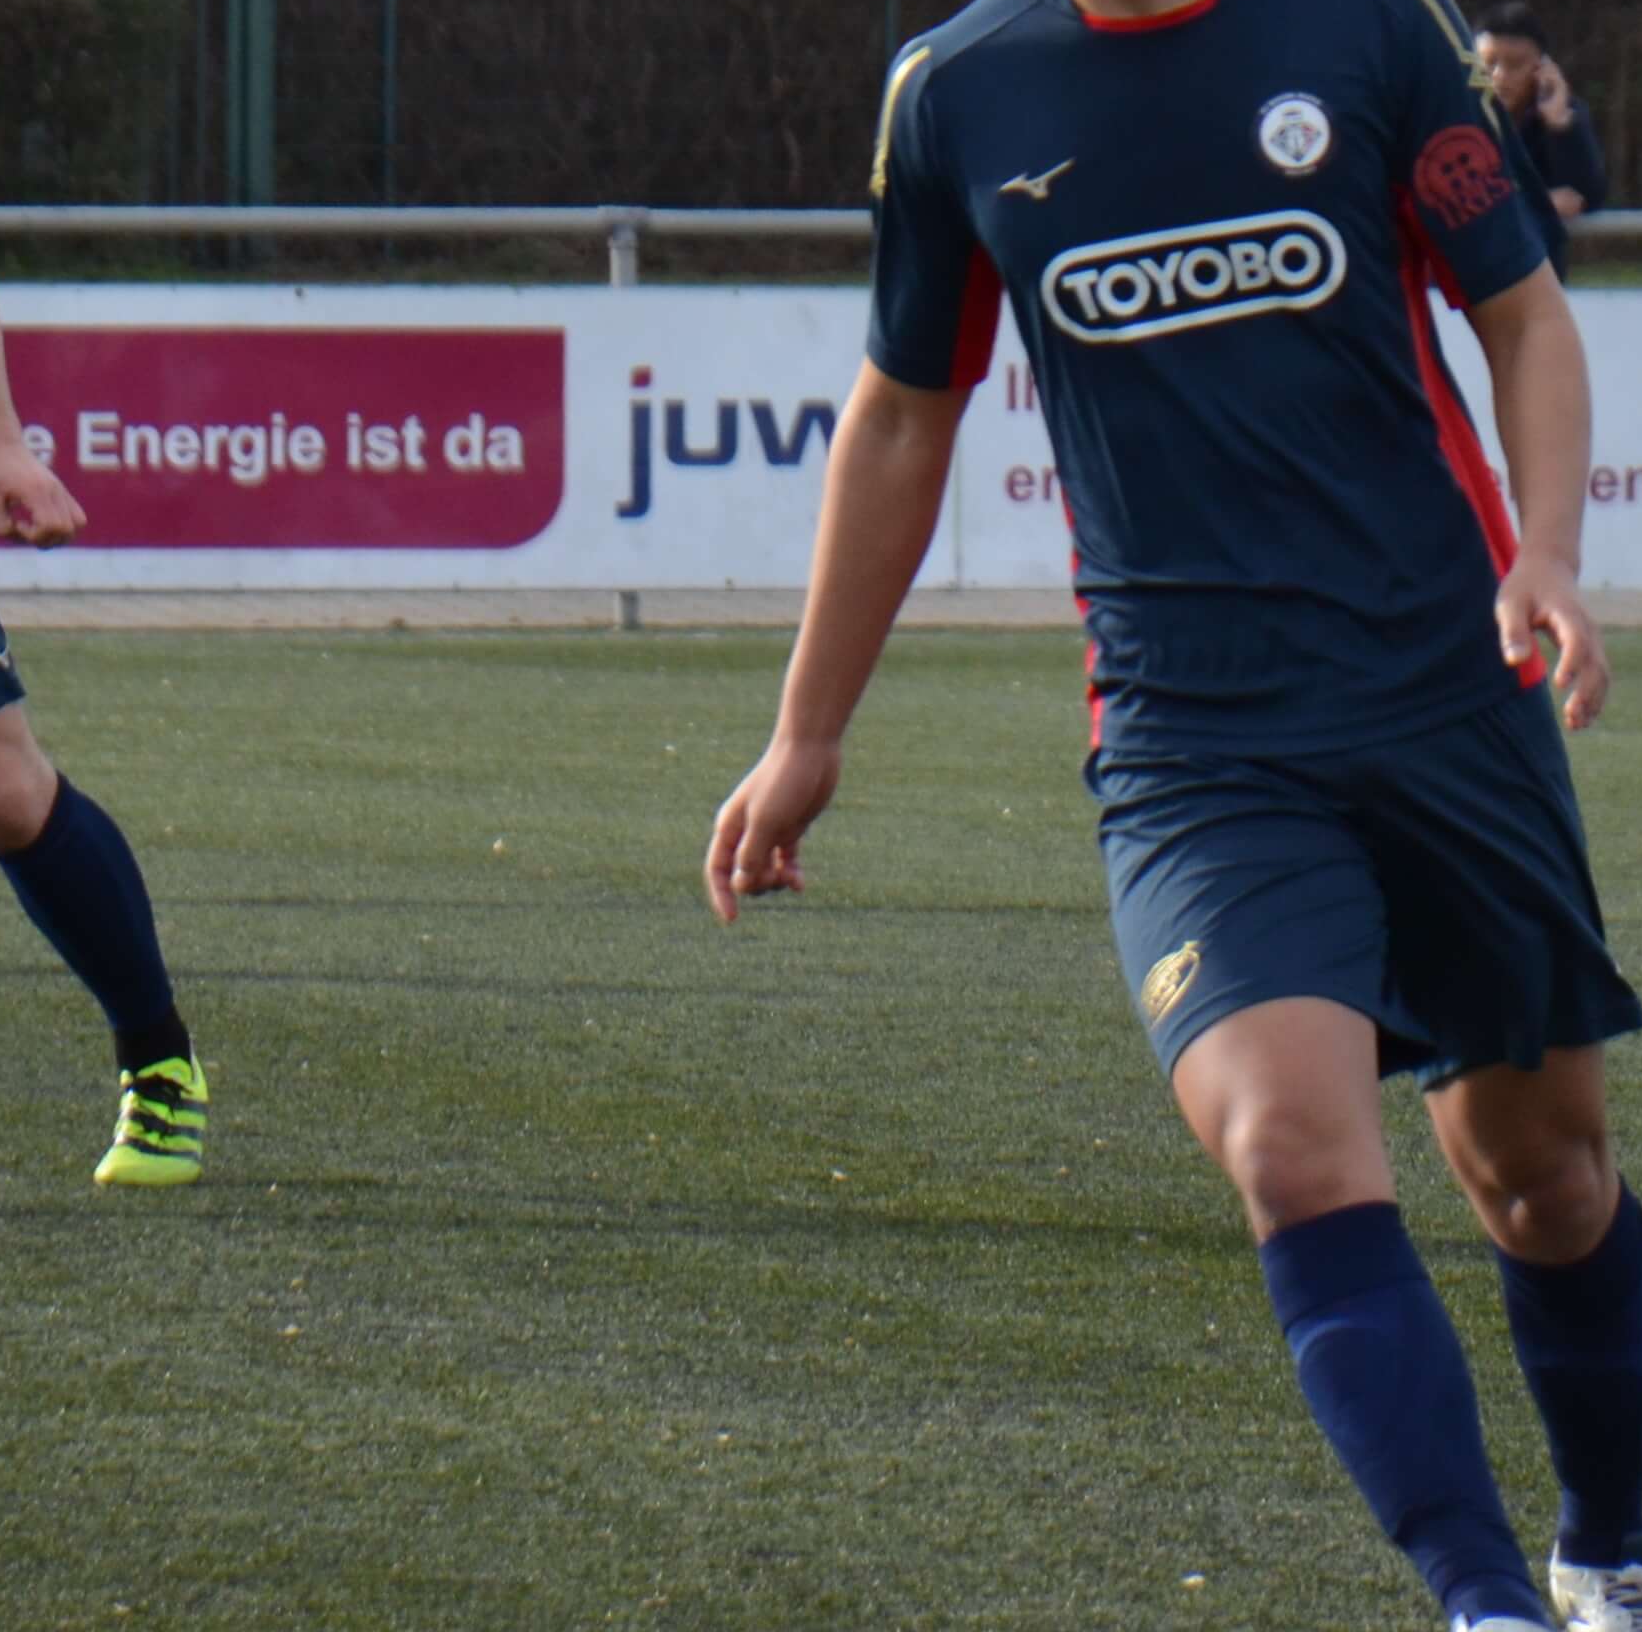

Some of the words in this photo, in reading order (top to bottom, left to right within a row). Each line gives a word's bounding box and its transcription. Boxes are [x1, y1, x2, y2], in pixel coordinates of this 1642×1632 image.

[1060, 232, 1322, 322] TOYOBO
[77, 412, 325, 486] Energie
[346, 412, 425, 468] ist
[444, 414, 524, 468] da
[615, 366, 839, 518] juw
